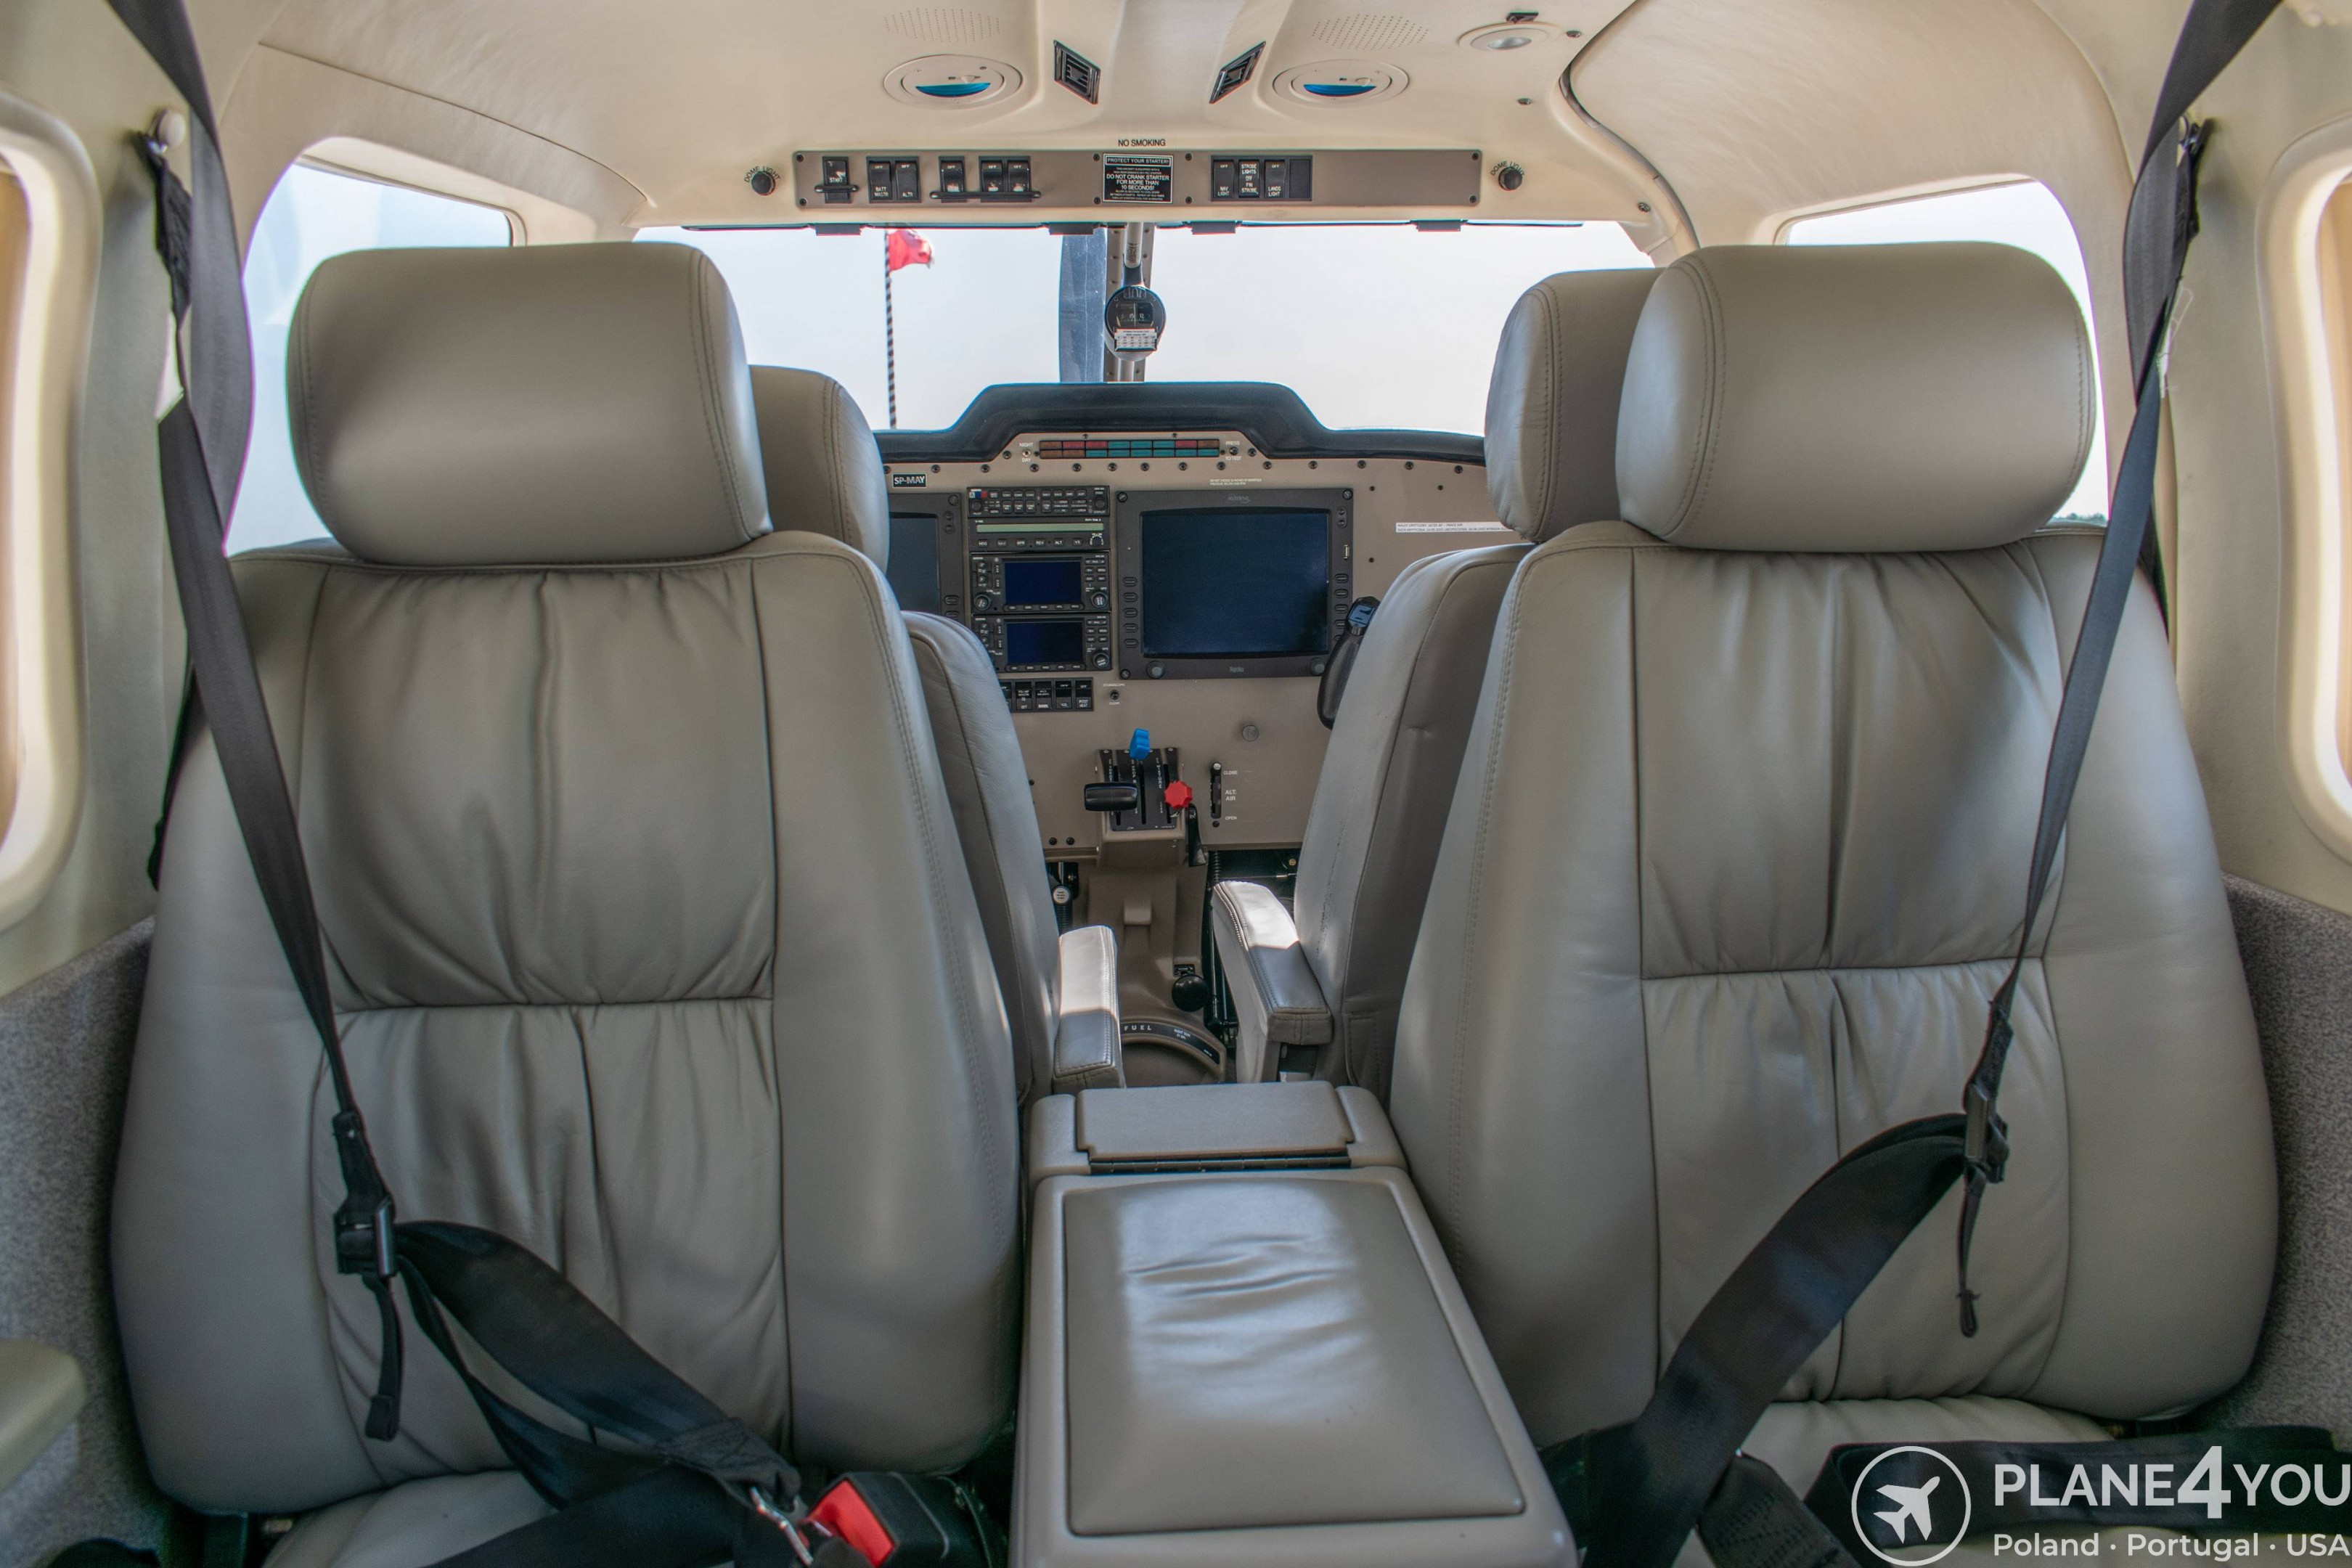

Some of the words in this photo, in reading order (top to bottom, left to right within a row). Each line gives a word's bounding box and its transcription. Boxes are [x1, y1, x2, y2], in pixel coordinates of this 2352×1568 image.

[744, 166, 759, 183] DOME
[763, 166, 780, 180] LIGHT
[1490, 161, 1508, 176] DOME
[1510, 162, 1525, 176] LIGHT
